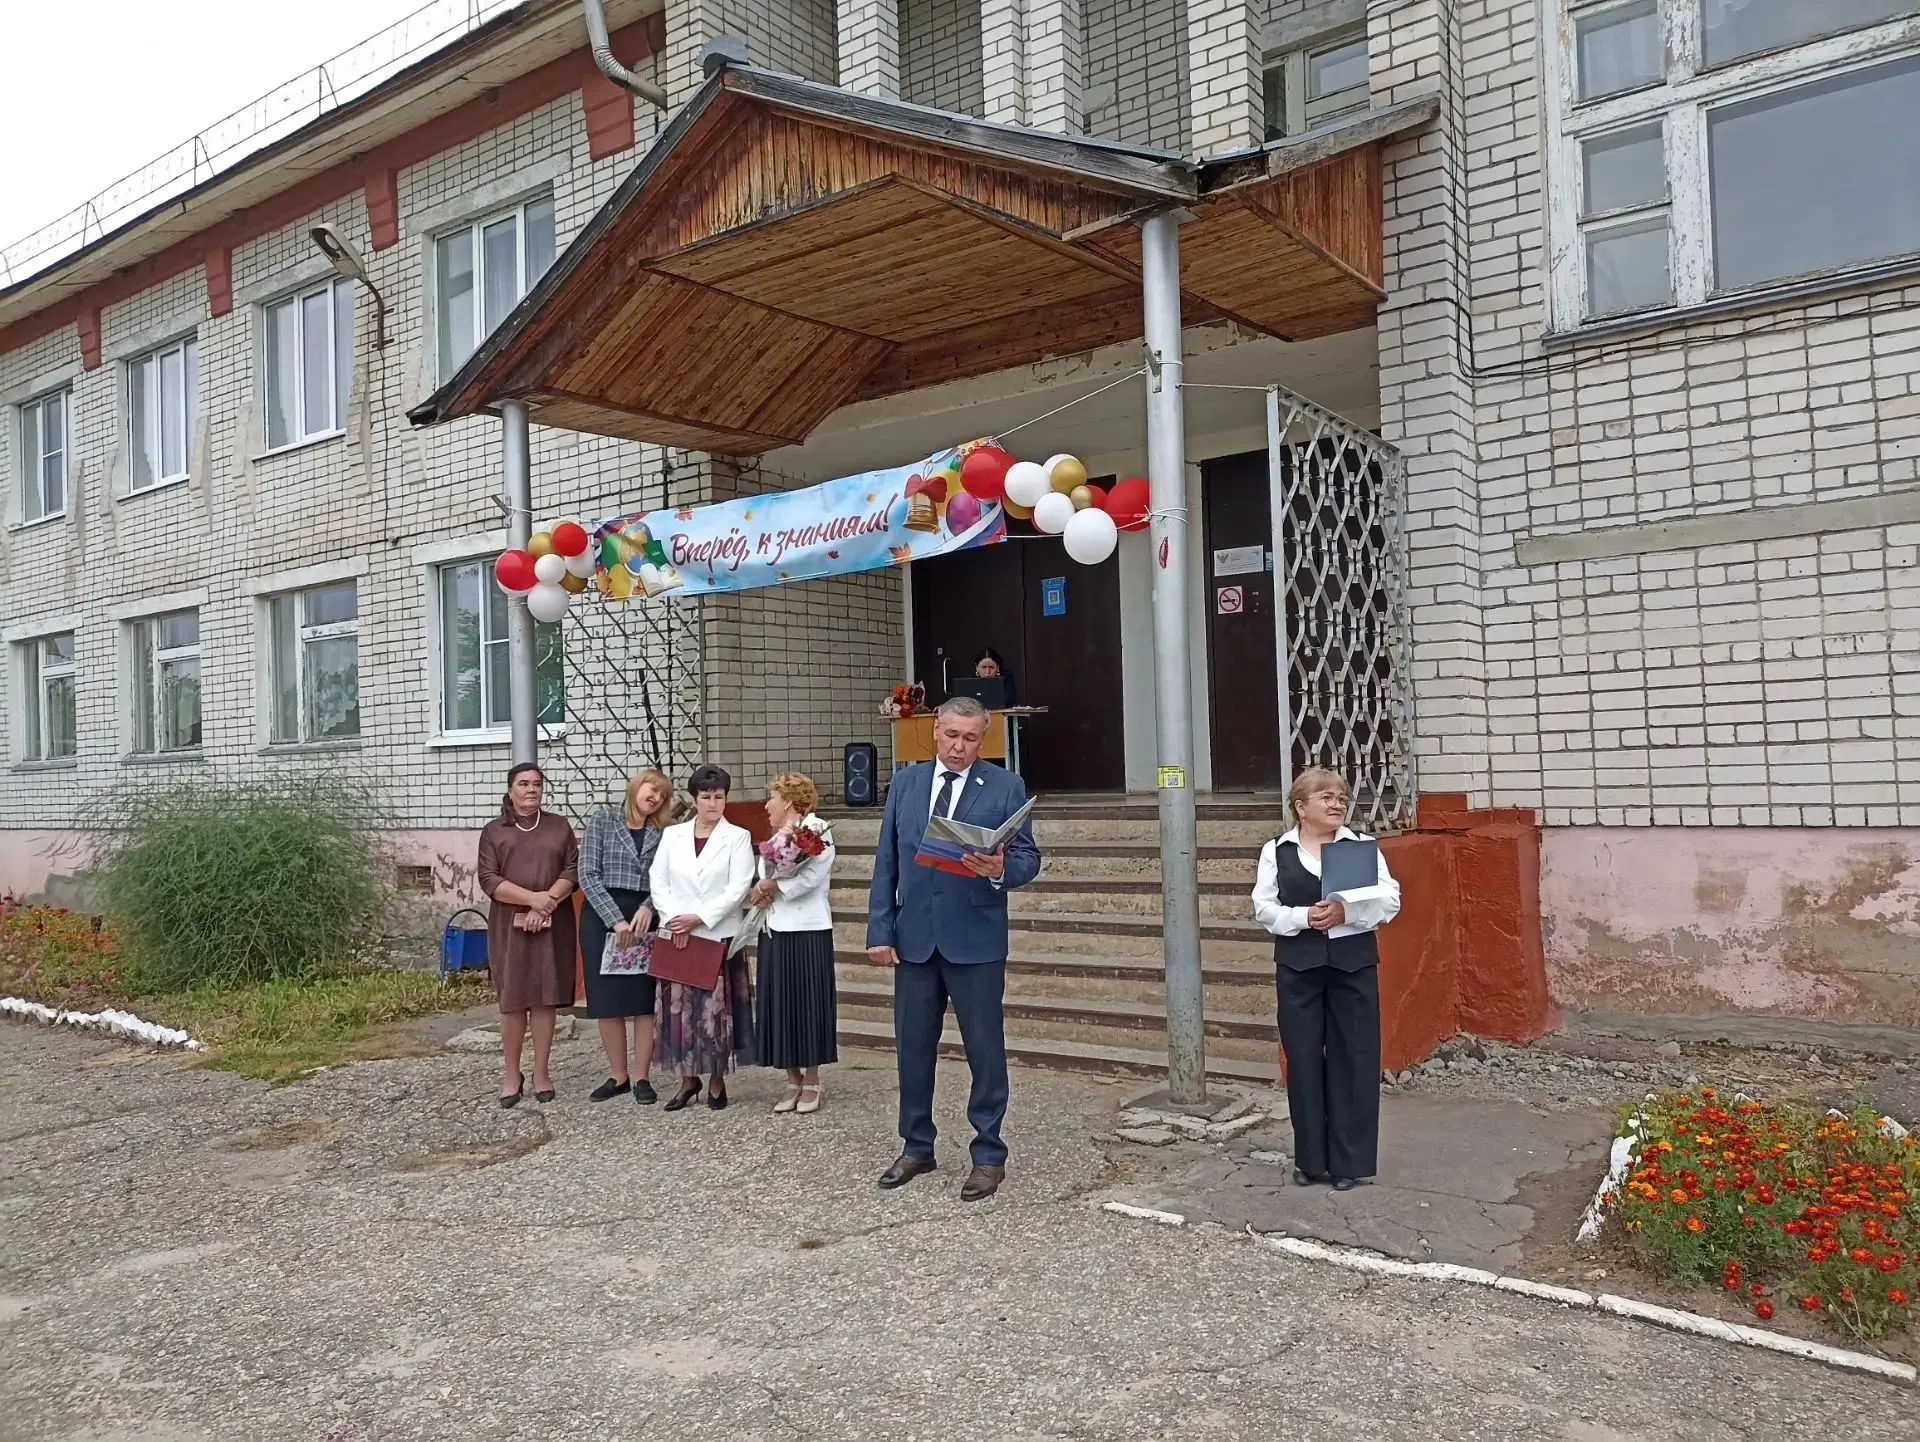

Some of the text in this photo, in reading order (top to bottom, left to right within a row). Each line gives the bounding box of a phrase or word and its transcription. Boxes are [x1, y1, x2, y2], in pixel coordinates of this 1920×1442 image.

[670, 492, 899, 573] Вперёд, к знаниям!
